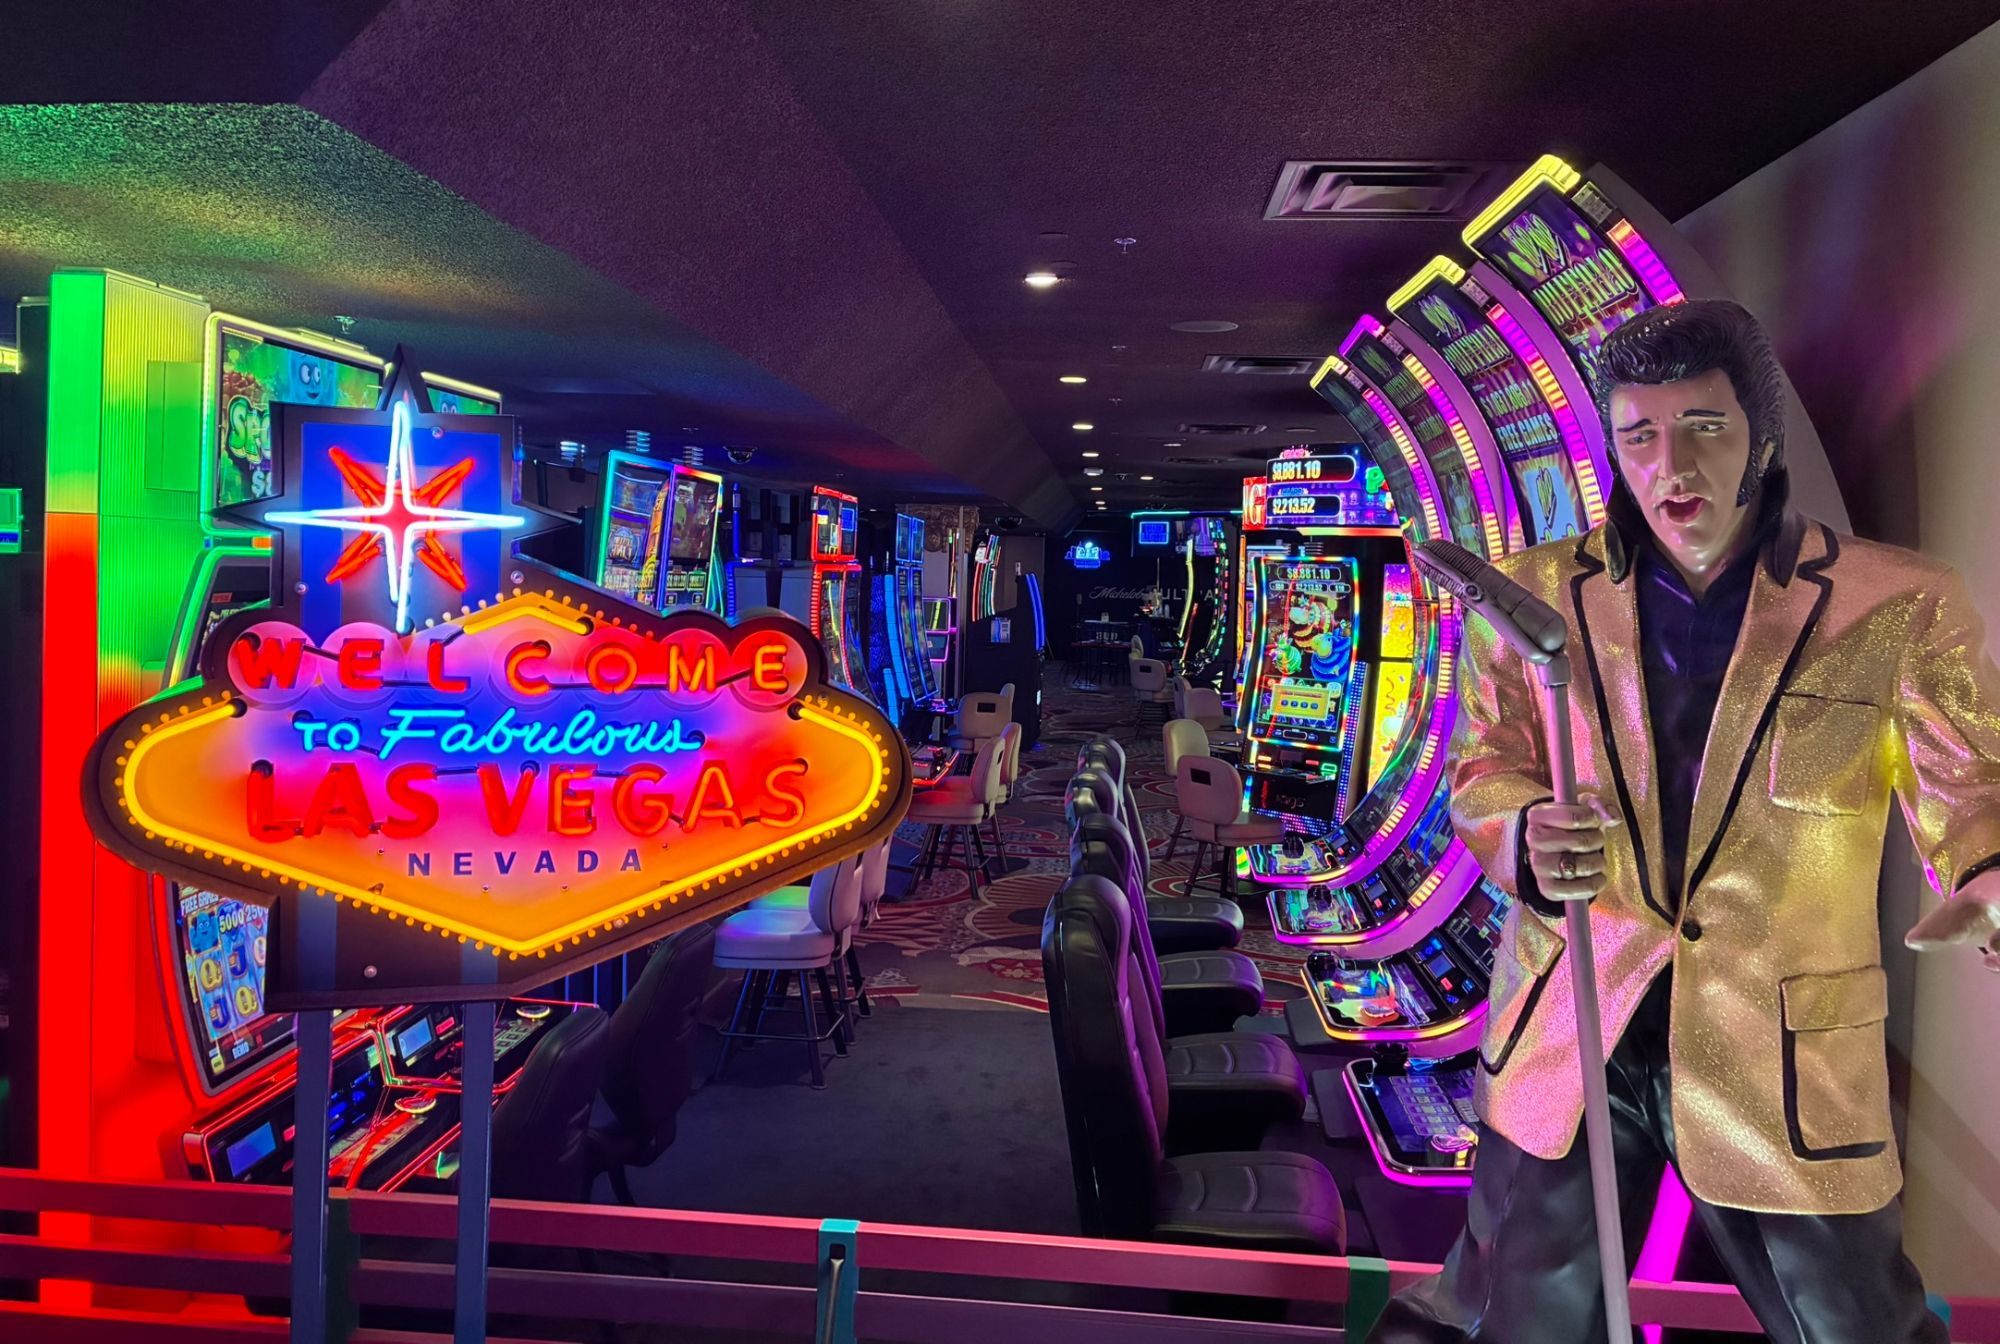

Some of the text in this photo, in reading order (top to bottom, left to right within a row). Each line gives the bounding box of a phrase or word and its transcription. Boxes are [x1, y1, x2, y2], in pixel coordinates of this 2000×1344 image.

[1495, 411, 1558, 451] FREE GAMES
[1088, 585, 1215, 601] Michelob ULTA
[237, 636, 790, 696] WELCOME
[293, 706, 702, 760] TO Fabulous
[246, 758, 809, 844] LAS VEGAS
[407, 847, 643, 878] NEVADA
[219, 909, 244, 933] 5000
